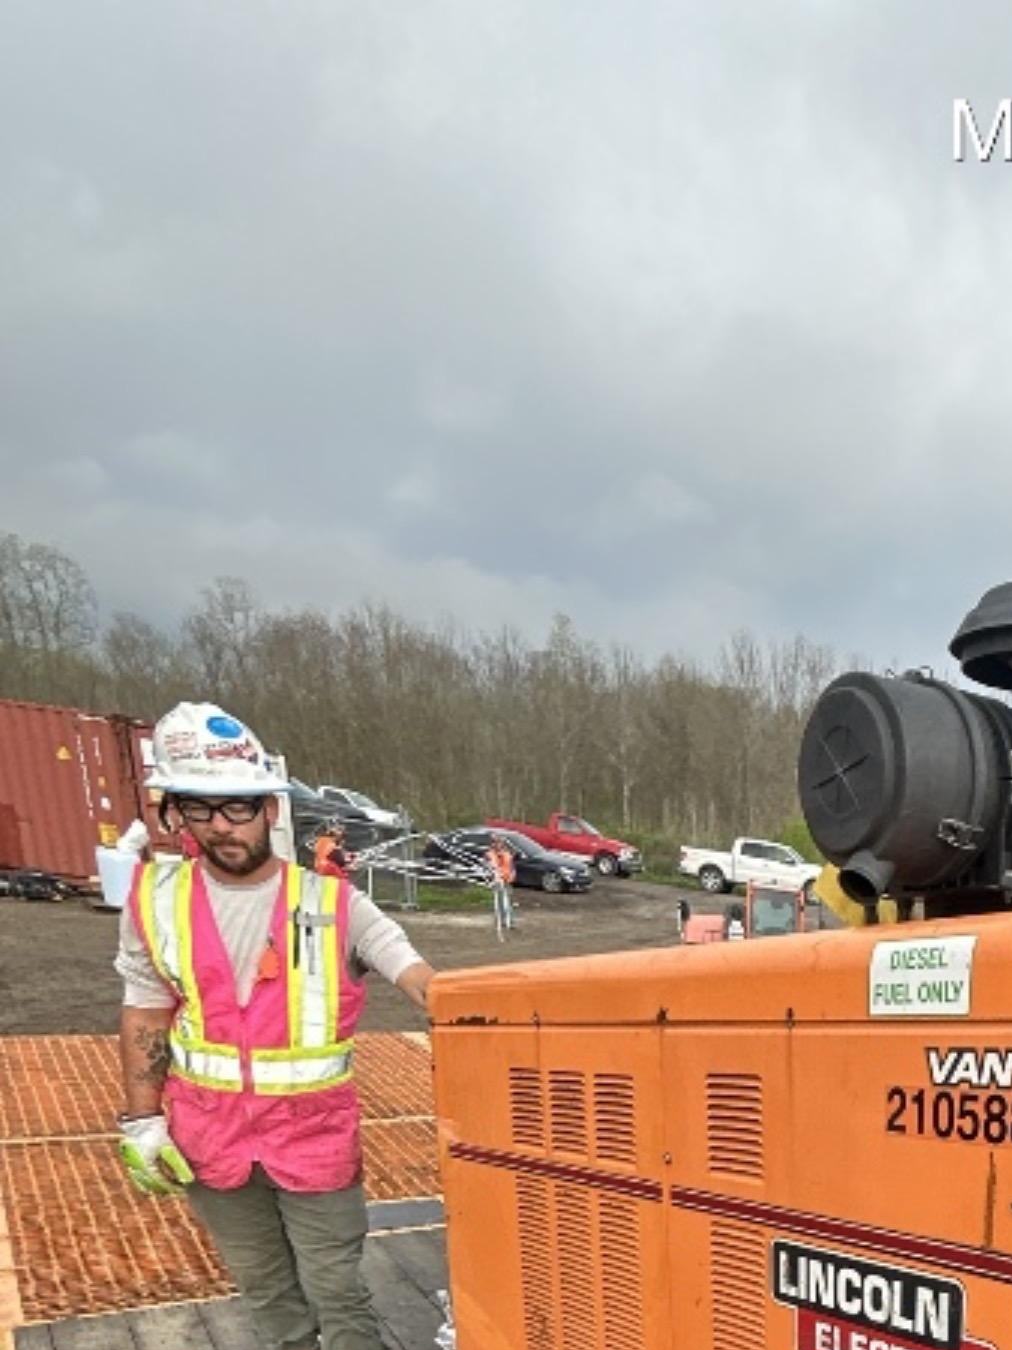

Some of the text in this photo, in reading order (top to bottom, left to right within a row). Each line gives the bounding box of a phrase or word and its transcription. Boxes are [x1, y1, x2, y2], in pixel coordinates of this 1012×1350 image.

[889, 945, 949, 970] DIESEL
[874, 980, 965, 1006] FUEL ONLY
[778, 1250, 950, 1342] LINCOLN
